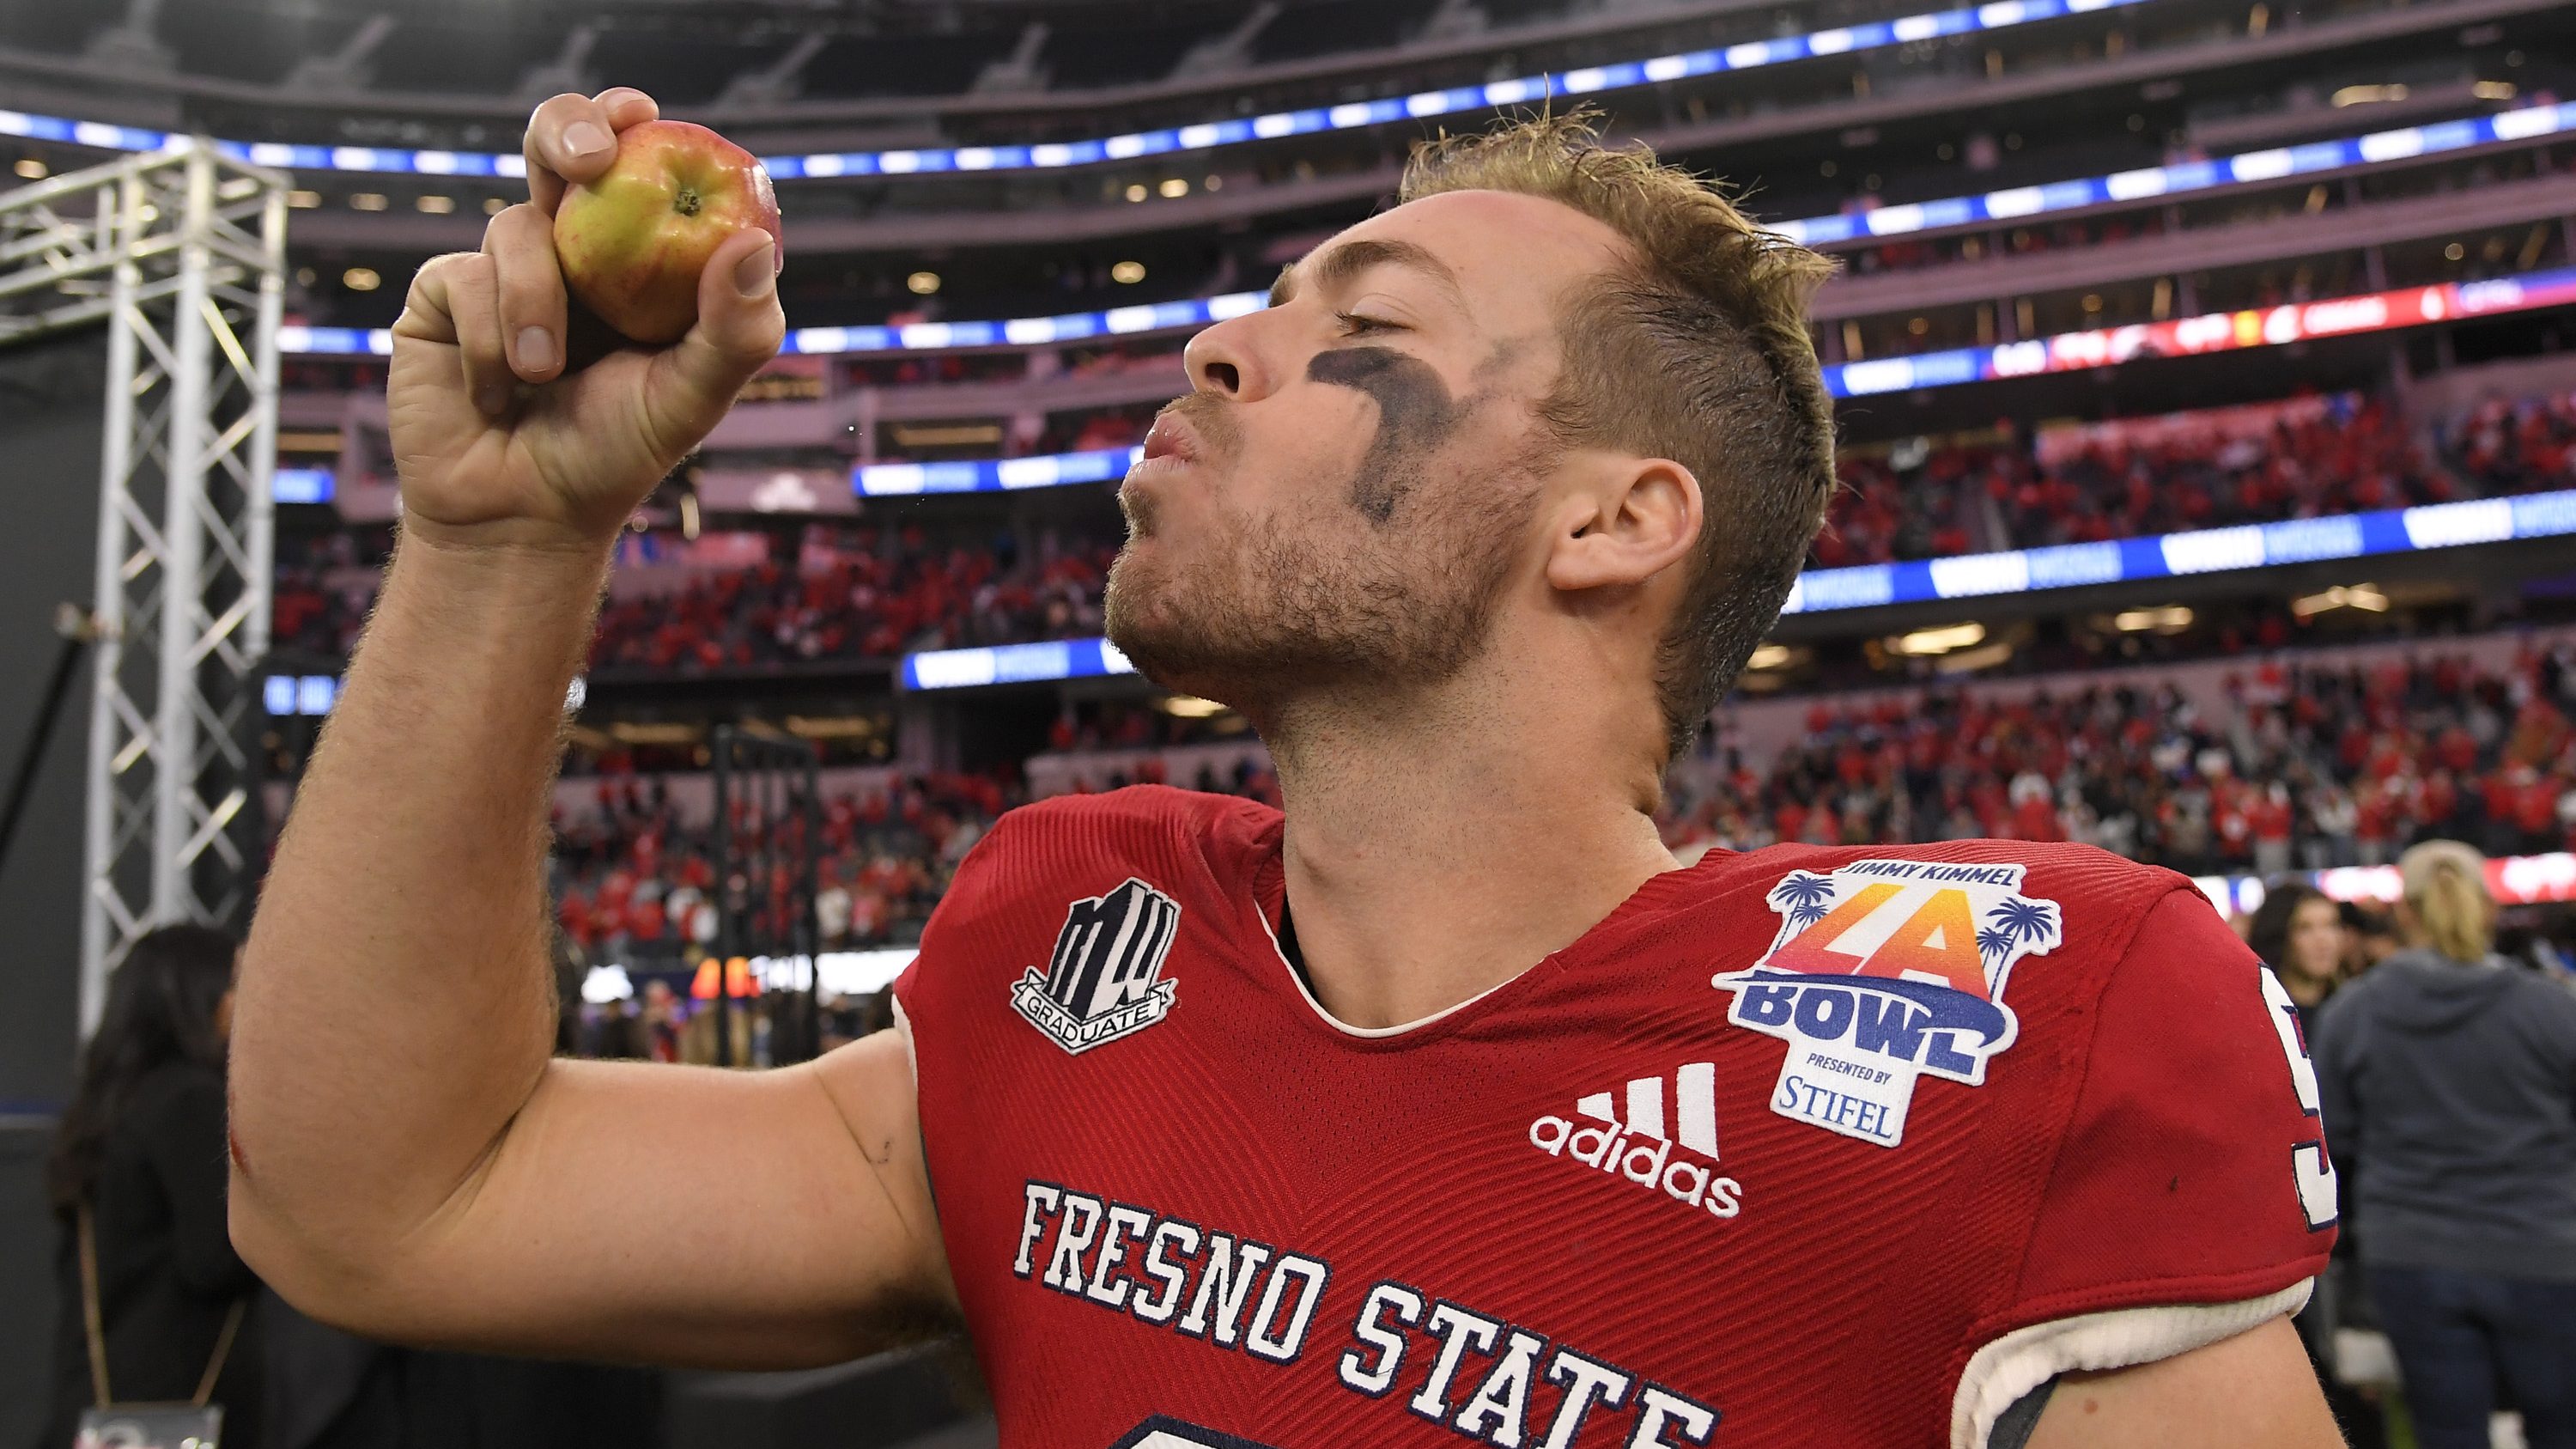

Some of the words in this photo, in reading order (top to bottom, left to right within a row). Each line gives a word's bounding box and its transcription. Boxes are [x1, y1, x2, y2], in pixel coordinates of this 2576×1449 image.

[1840, 861, 1919, 879] JIMMY
[1923, 865, 2017, 886] KIMMEL
[1763, 882, 1993, 1003] LA
[1027, 995, 1151, 1043] GRADUATE
[1737, 984, 1977, 1076] BOWL
[1778, 1075, 1893, 1140] STIFEL
[1806, 1052, 1873, 1081] PRESENTED
[1874, 1071, 1893, 1086] BY
[1528, 1115, 1743, 1219] adidas
[1012, 1178, 1333, 1366] FRESNO
